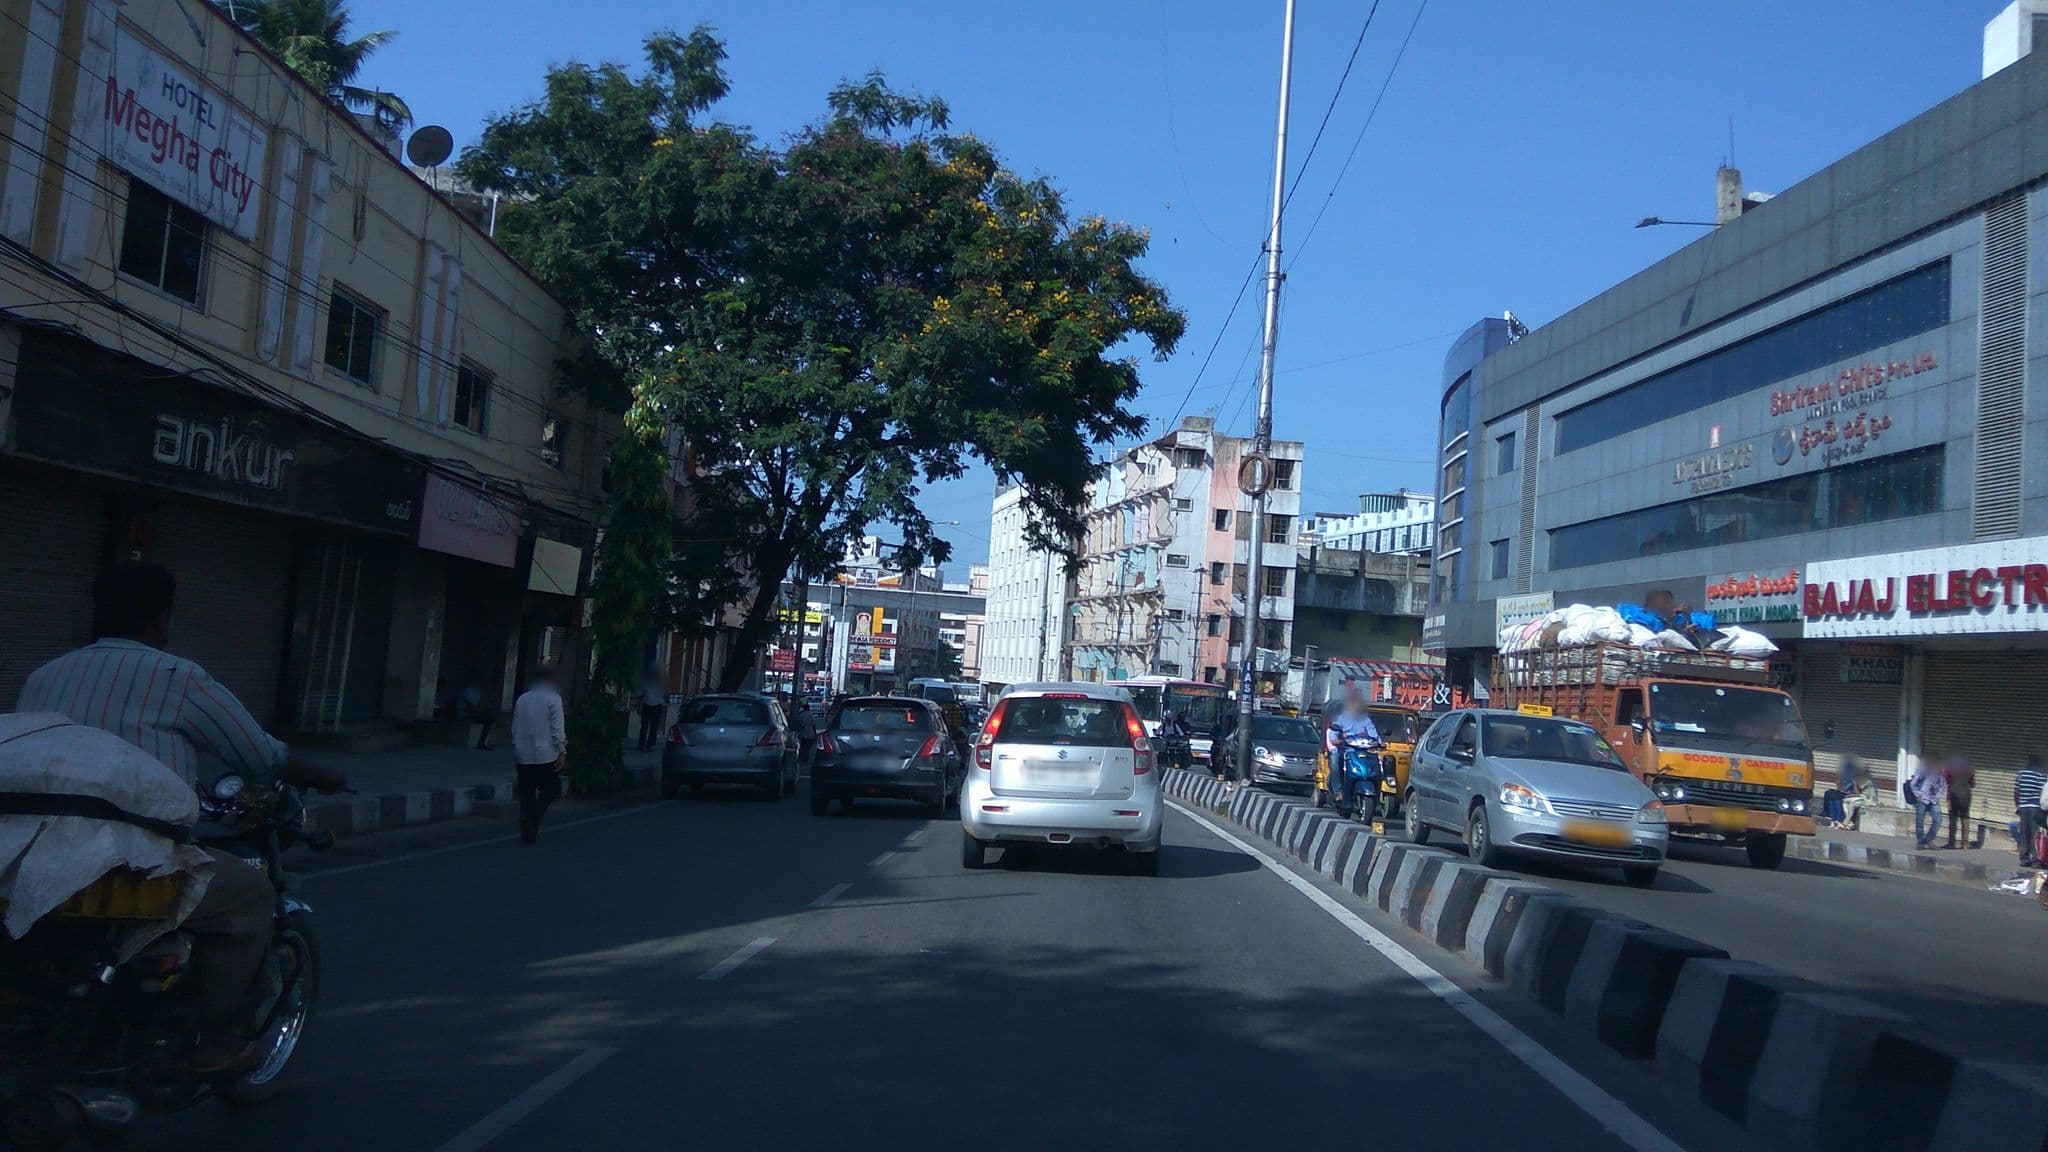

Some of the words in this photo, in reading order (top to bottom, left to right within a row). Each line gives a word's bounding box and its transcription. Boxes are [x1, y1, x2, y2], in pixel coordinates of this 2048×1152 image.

[162, 72, 216, 130] HOTEL
[104, 76, 199, 174] Megha
[210, 148, 254, 213] City
[1770, 382, 1831, 416] Shriram
[1837, 361, 1884, 397] Chits
[152, 414, 295, 490] ankur
[1804, 577, 1894, 616] BAJAJ
[1907, 564, 2048, 611] ELECTR
[1433, 683, 1450, 705] &
[1683, 753, 1724, 764] GOODS
[1745, 759, 1786, 770] CARRIER
[1702, 780, 1765, 794] EICHER
